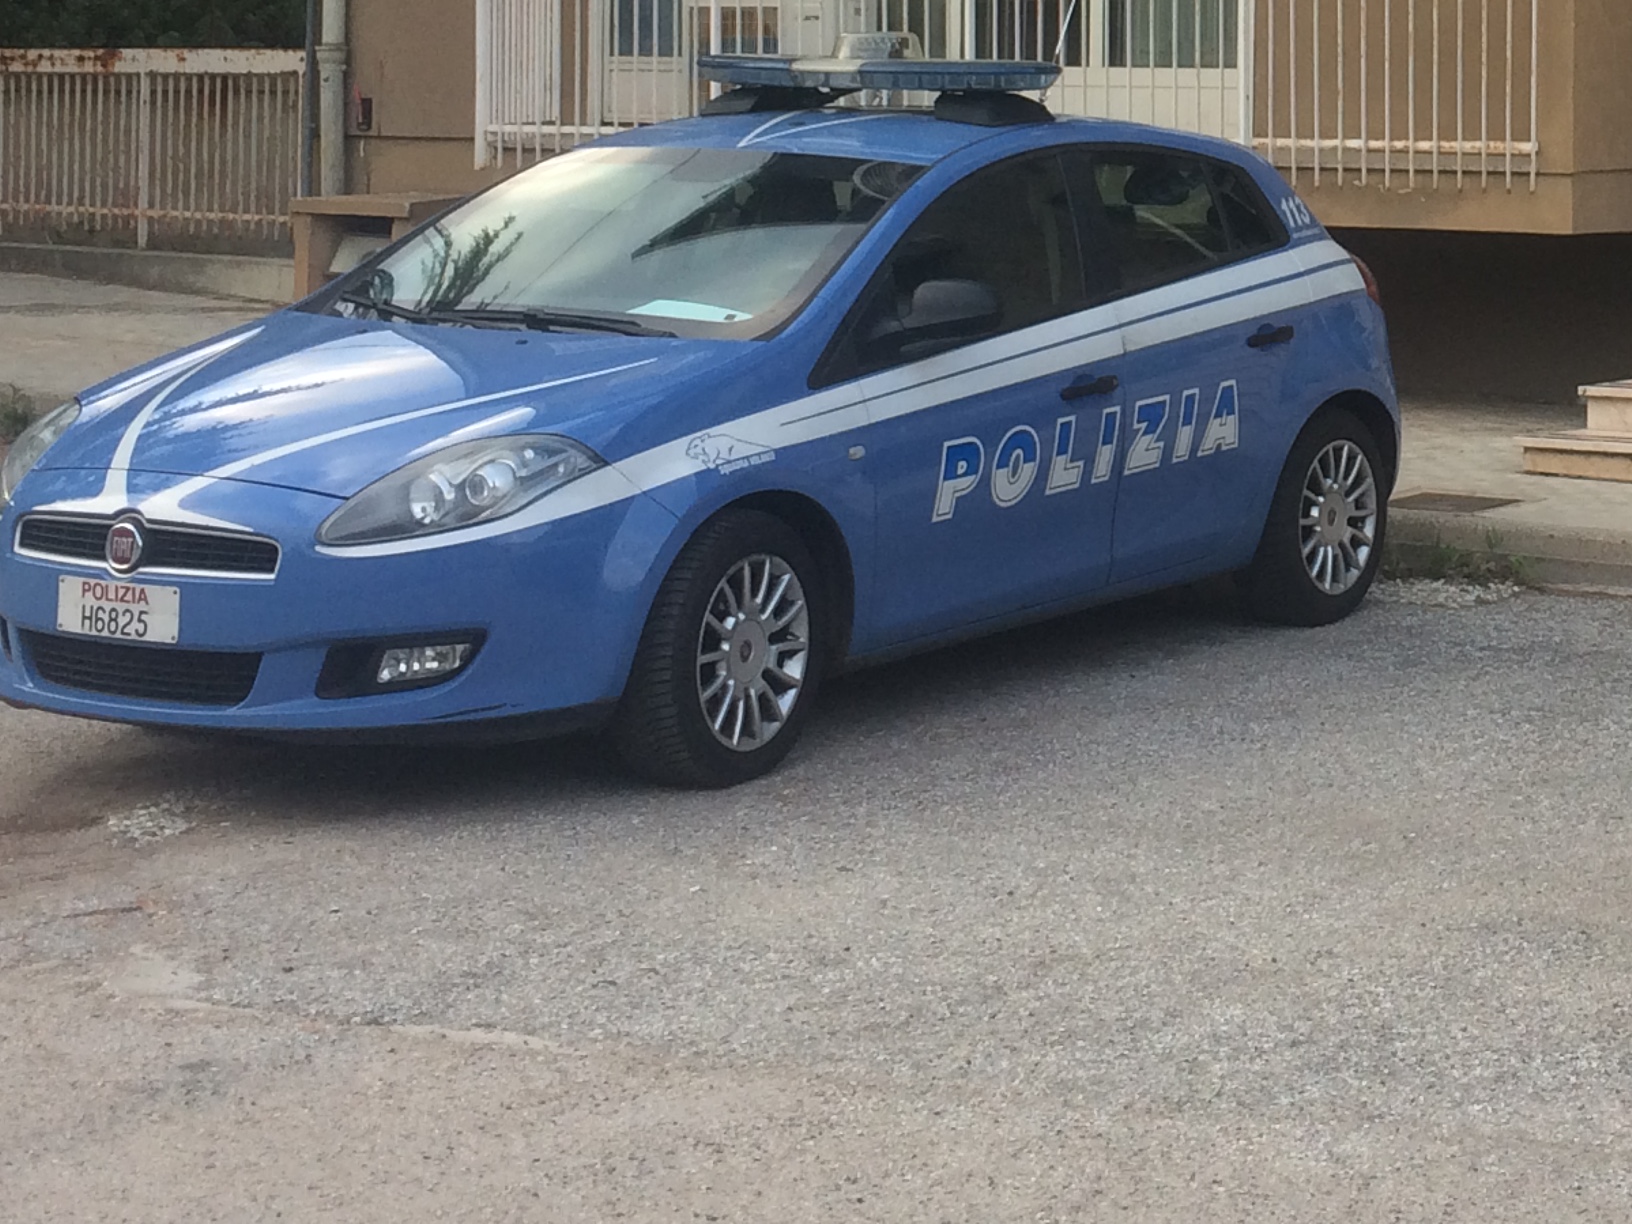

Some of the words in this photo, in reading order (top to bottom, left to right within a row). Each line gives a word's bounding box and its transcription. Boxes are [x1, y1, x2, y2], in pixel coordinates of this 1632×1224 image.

[1280, 195, 1311, 228] 113
[931, 379, 1239, 523] POLIZIA
[113, 536, 134, 558] FIAT
[81, 580, 149, 605] POLIZIA
[80, 604, 149, 638] H6825
